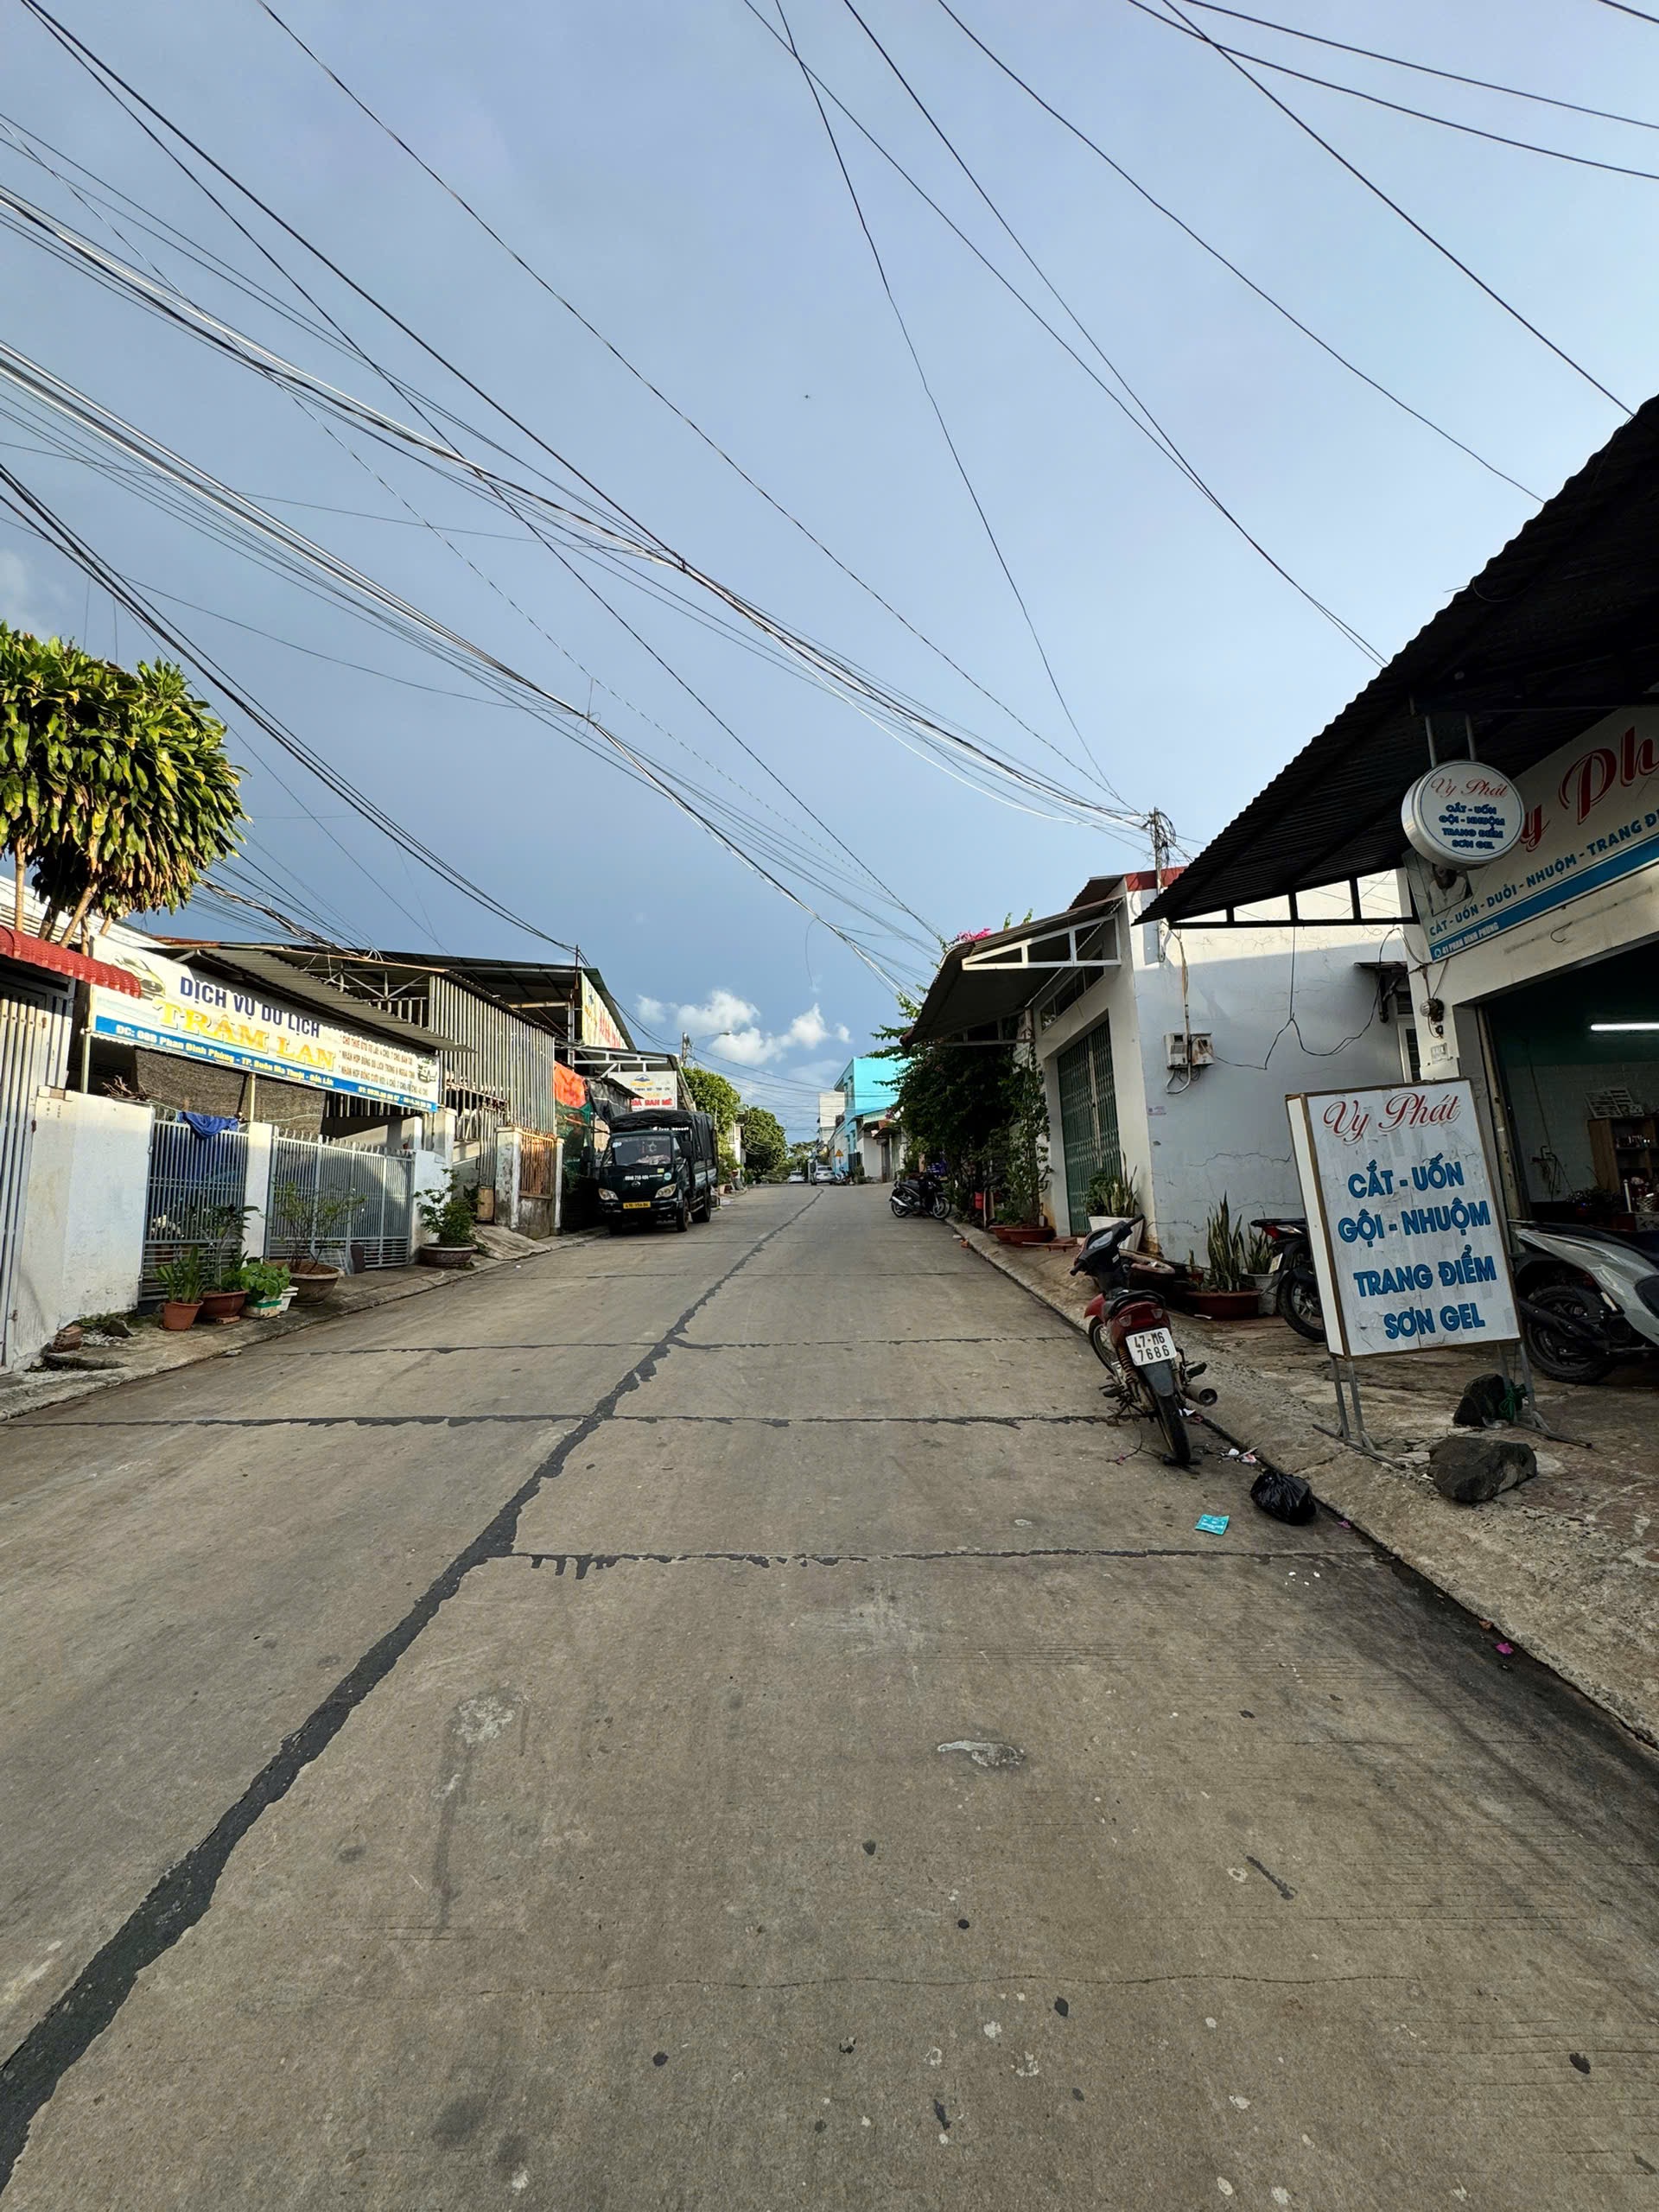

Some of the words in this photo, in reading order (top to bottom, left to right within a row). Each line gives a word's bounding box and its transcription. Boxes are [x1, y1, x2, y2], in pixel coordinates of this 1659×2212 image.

[1430, 779, 1457, 798] Vy
[1460, 779, 1508, 798] Phát
[1558, 726, 1659, 825] Ph
[1439, 814, 1459, 825] GỘI
[1474, 804, 1497, 815] UỐN
[1442, 828, 1477, 837] TRANG
[1452, 839, 1473, 849] SƠN
[1475, 841, 1495, 849] GEL
[1526, 854, 1577, 887] NHUỘM
[1586, 819, 1643, 856] TRANG
[181, 976, 227, 1008] DỊCH
[233, 995, 255, 1020] VỤ
[262, 1003, 283, 1026] DU
[288, 1014, 320, 1039] LỊCH
[115, 1024, 135, 1037] ĐC:
[159, 1036, 185, 1051] Phan
[153, 998, 270, 1054] TRÂM
[276, 1036, 336, 1071] LAN
[1323, 1099, 1370, 1145] Vy
[1377, 1092, 1462, 1134] Phát
[1348, 1159, 1394, 1198] CẮT
[1413, 1152, 1465, 1192] UỐN
[1338, 1209, 1385, 1247] GỘI
[1401, 1197, 1491, 1236] NHUỘM
[1353, 1263, 1433, 1297] TRANG
[1438, 1244, 1497, 1287] ĐIỂM
[1383, 1306, 1436, 1339] SƠN
[1440, 1302, 1485, 1332] GEL
[1137, 1344, 1170, 1362] 7686
